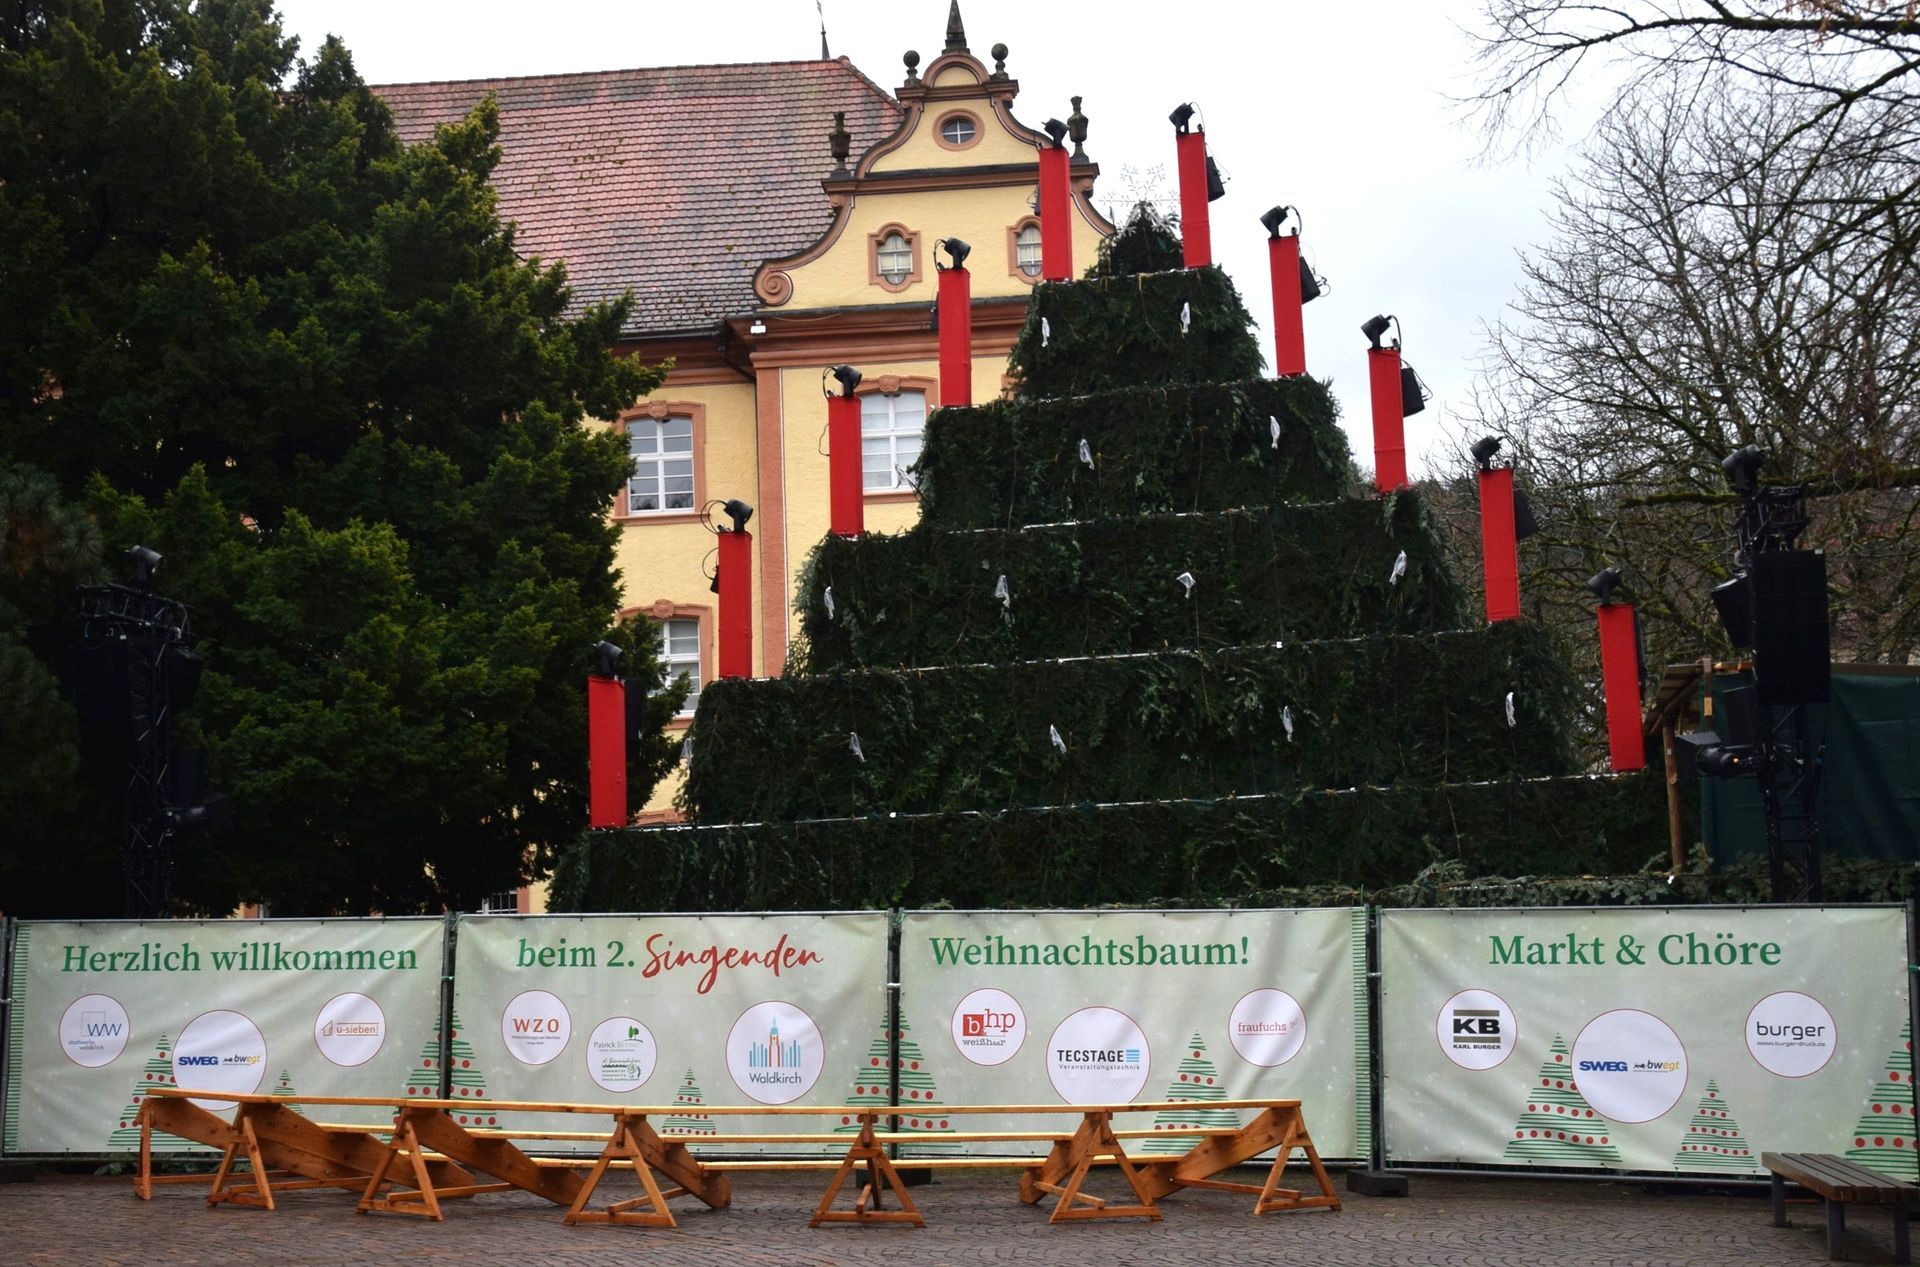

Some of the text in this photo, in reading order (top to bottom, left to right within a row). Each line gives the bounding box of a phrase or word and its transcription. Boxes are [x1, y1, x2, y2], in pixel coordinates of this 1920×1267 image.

[929, 935, 1250, 967] Weihnachtsbaum!
[1488, 932, 1782, 966] Markt & Chöre
[62, 942, 418, 972] Herzlich willkommen
[516, 933, 823, 995] beim 2. Singenden
[336, 1025, 376, 1034] u-sieben
[1238, 1022, 1287, 1032] fraufuchs
[1453, 1018, 1501, 1034] KB
[1756, 1021, 1826, 1041] burger
[593, 1041, 616, 1049] Patrick
[178, 1056, 219, 1066] SWEG
[1057, 1050, 1124, 1063] TECSTAGE
[1058, 1063, 1140, 1071] Veranstaltungstechnik
[1579, 1059, 1680, 1072] SWEG bwegt
[749, 1071, 801, 1085] Waldkirch
